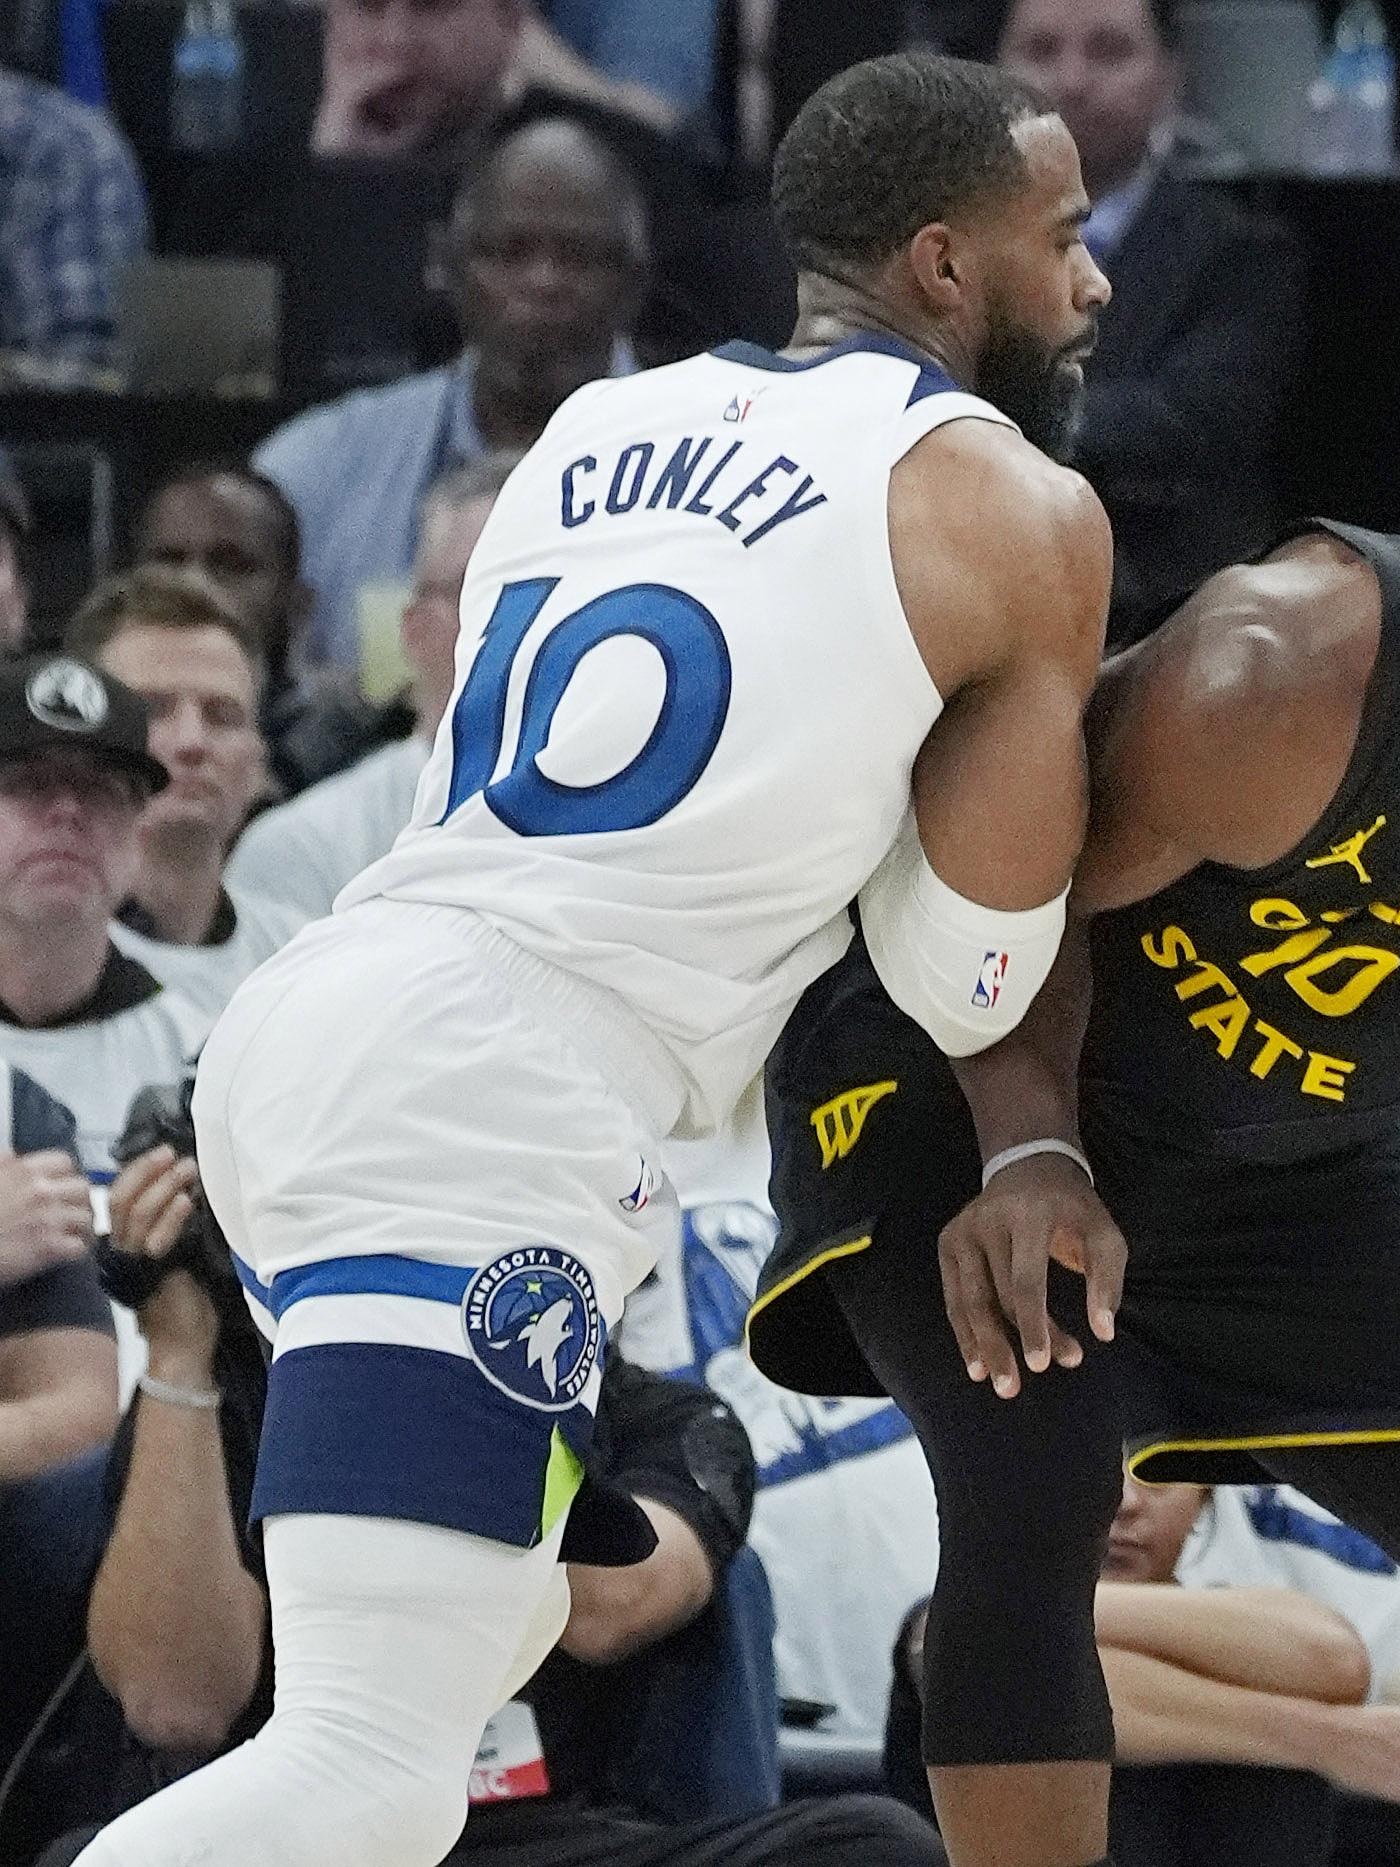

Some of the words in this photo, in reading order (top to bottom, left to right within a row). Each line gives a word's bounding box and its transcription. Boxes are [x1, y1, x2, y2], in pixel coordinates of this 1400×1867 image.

[560, 436, 828, 549] CONLEY
[436, 576, 733, 837] 10
[1140, 925, 1356, 1103] STATE
[469, 1250, 550, 1330] MINNESOTA
